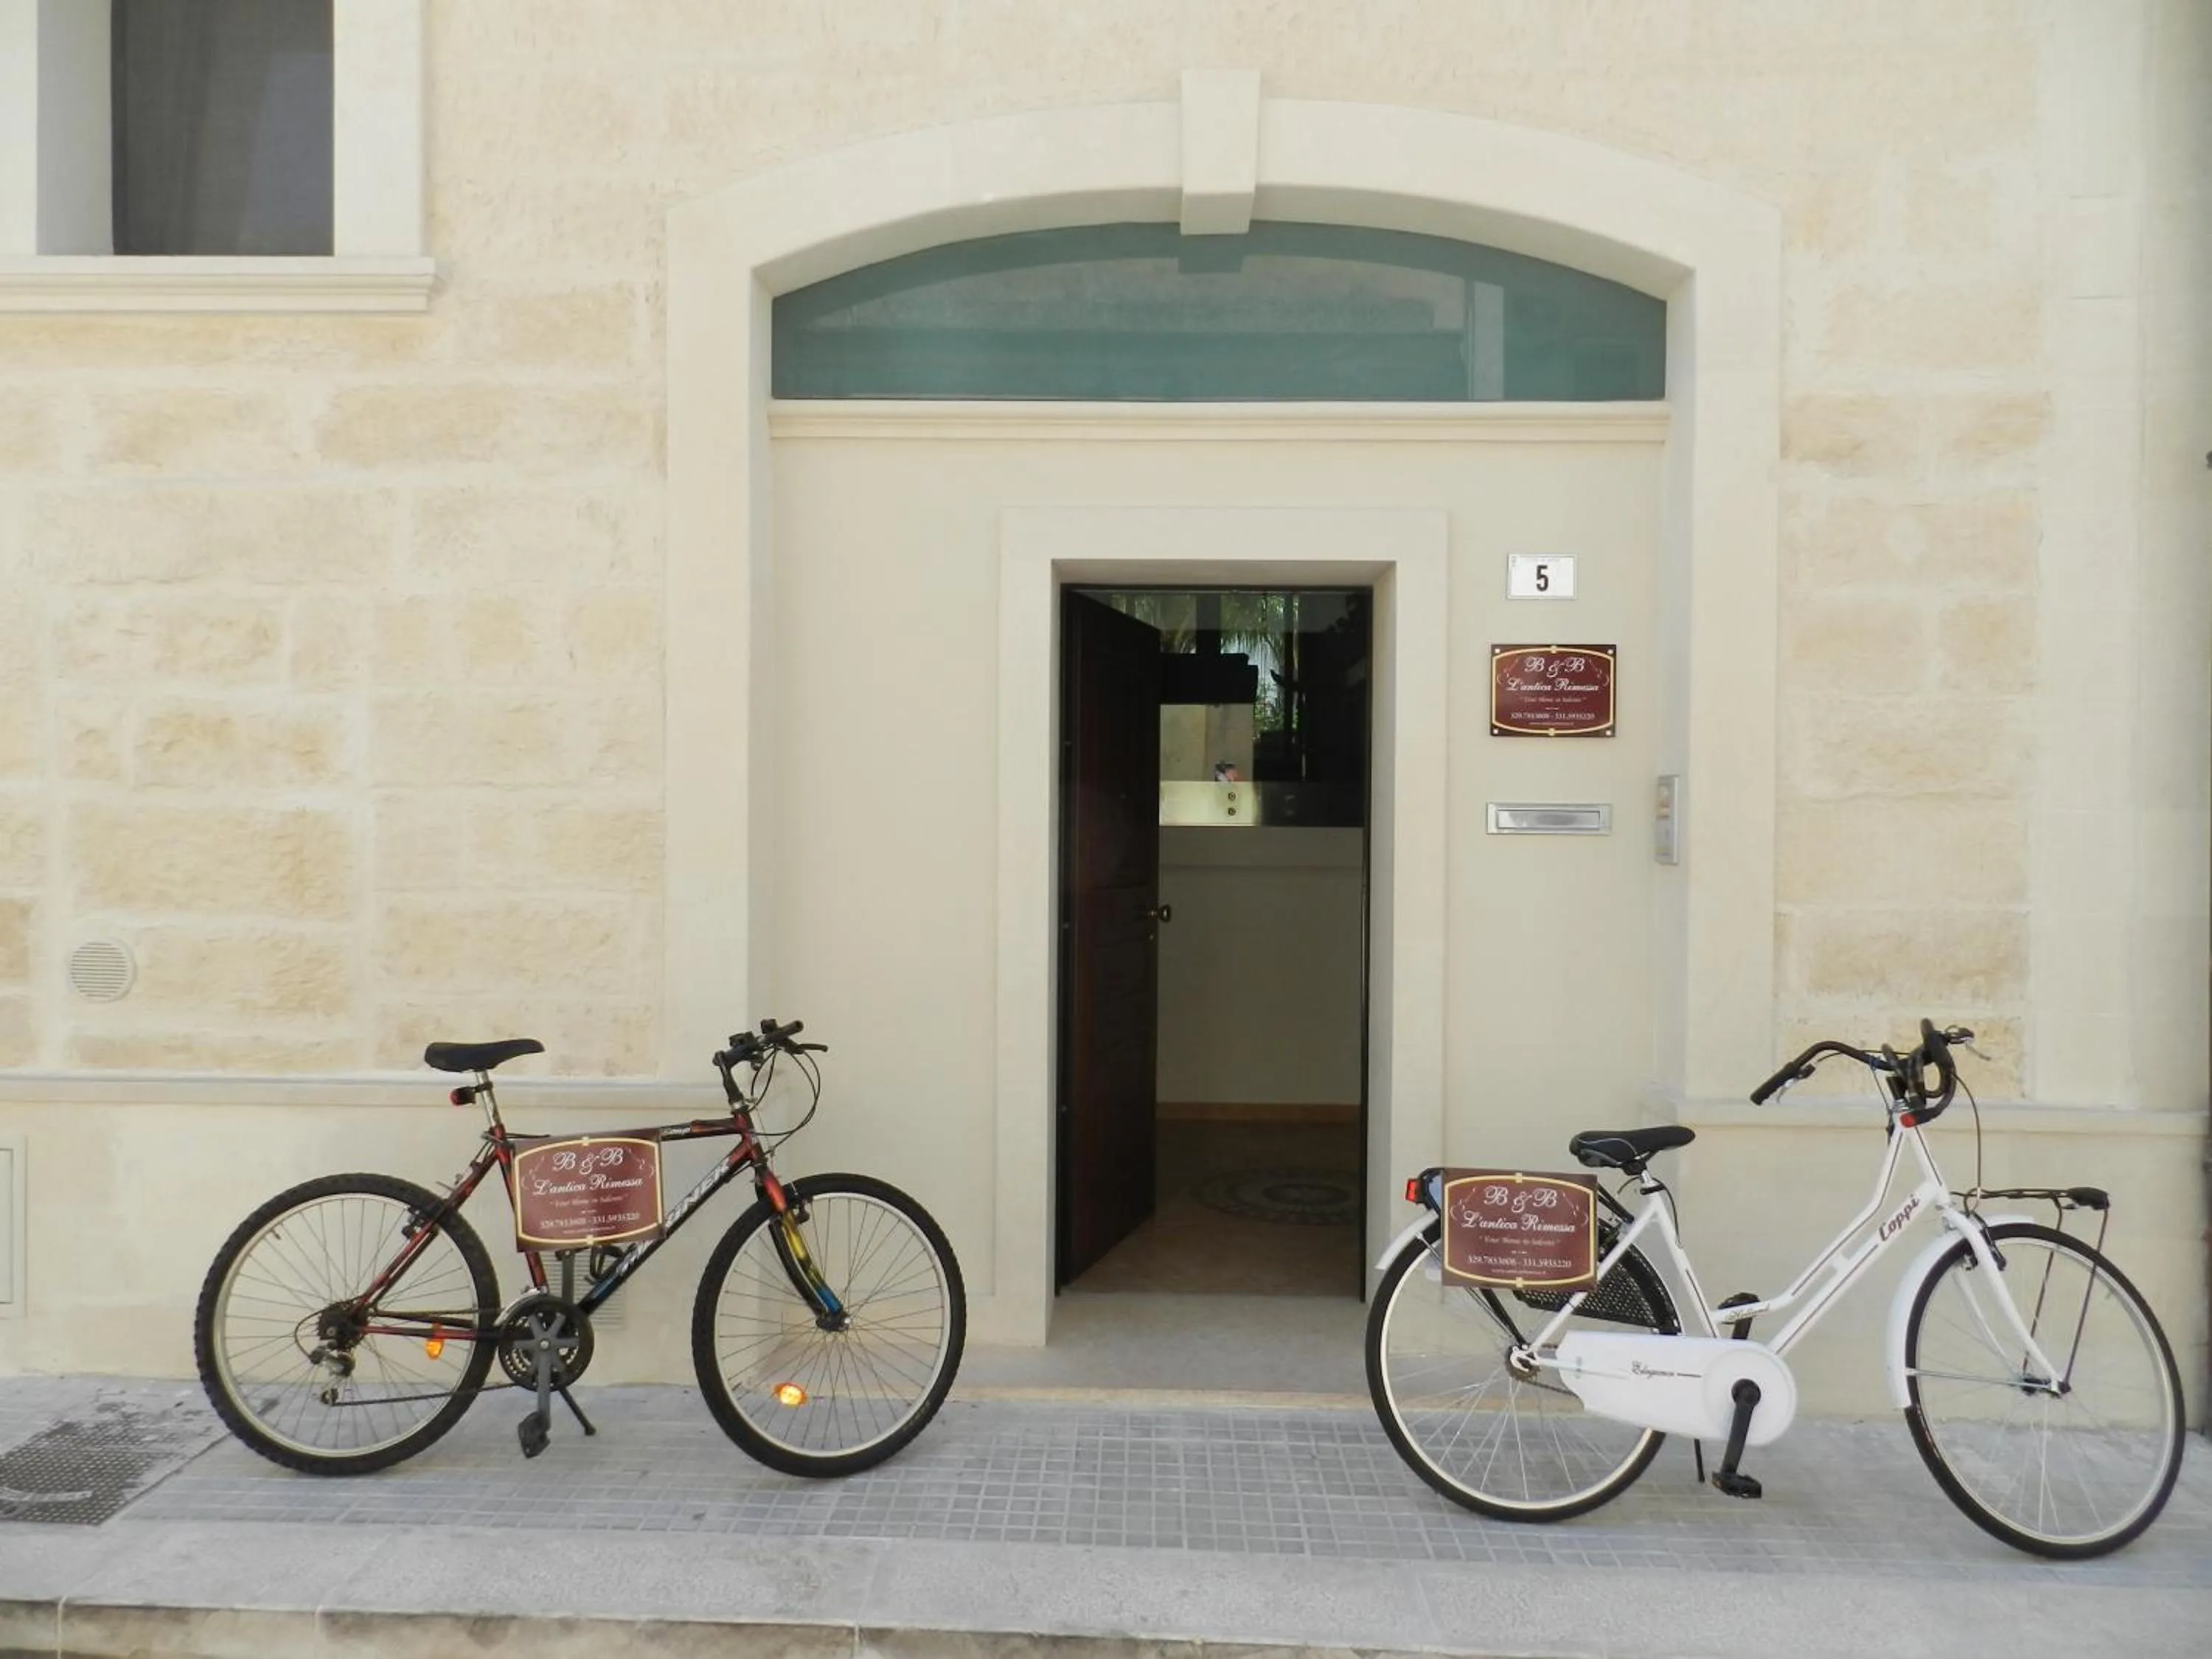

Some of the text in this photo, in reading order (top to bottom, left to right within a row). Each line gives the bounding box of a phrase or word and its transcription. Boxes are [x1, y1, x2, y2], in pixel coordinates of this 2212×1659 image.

[1536, 564, 1549, 592] 5
[1523, 656, 1545, 672] B
[1564, 656, 1585, 672] B
[1506, 677, 1599, 692] L'antica Rimessa
[552, 1151, 577, 1171] B
[599, 1147, 624, 1167] B
[532, 1173, 643, 1197] L'antica Rimessa
[1484, 1185, 1508, 1206] B
[1532, 1188, 1557, 1208] B
[1461, 1210, 1576, 1233] L'antica Rimessa
